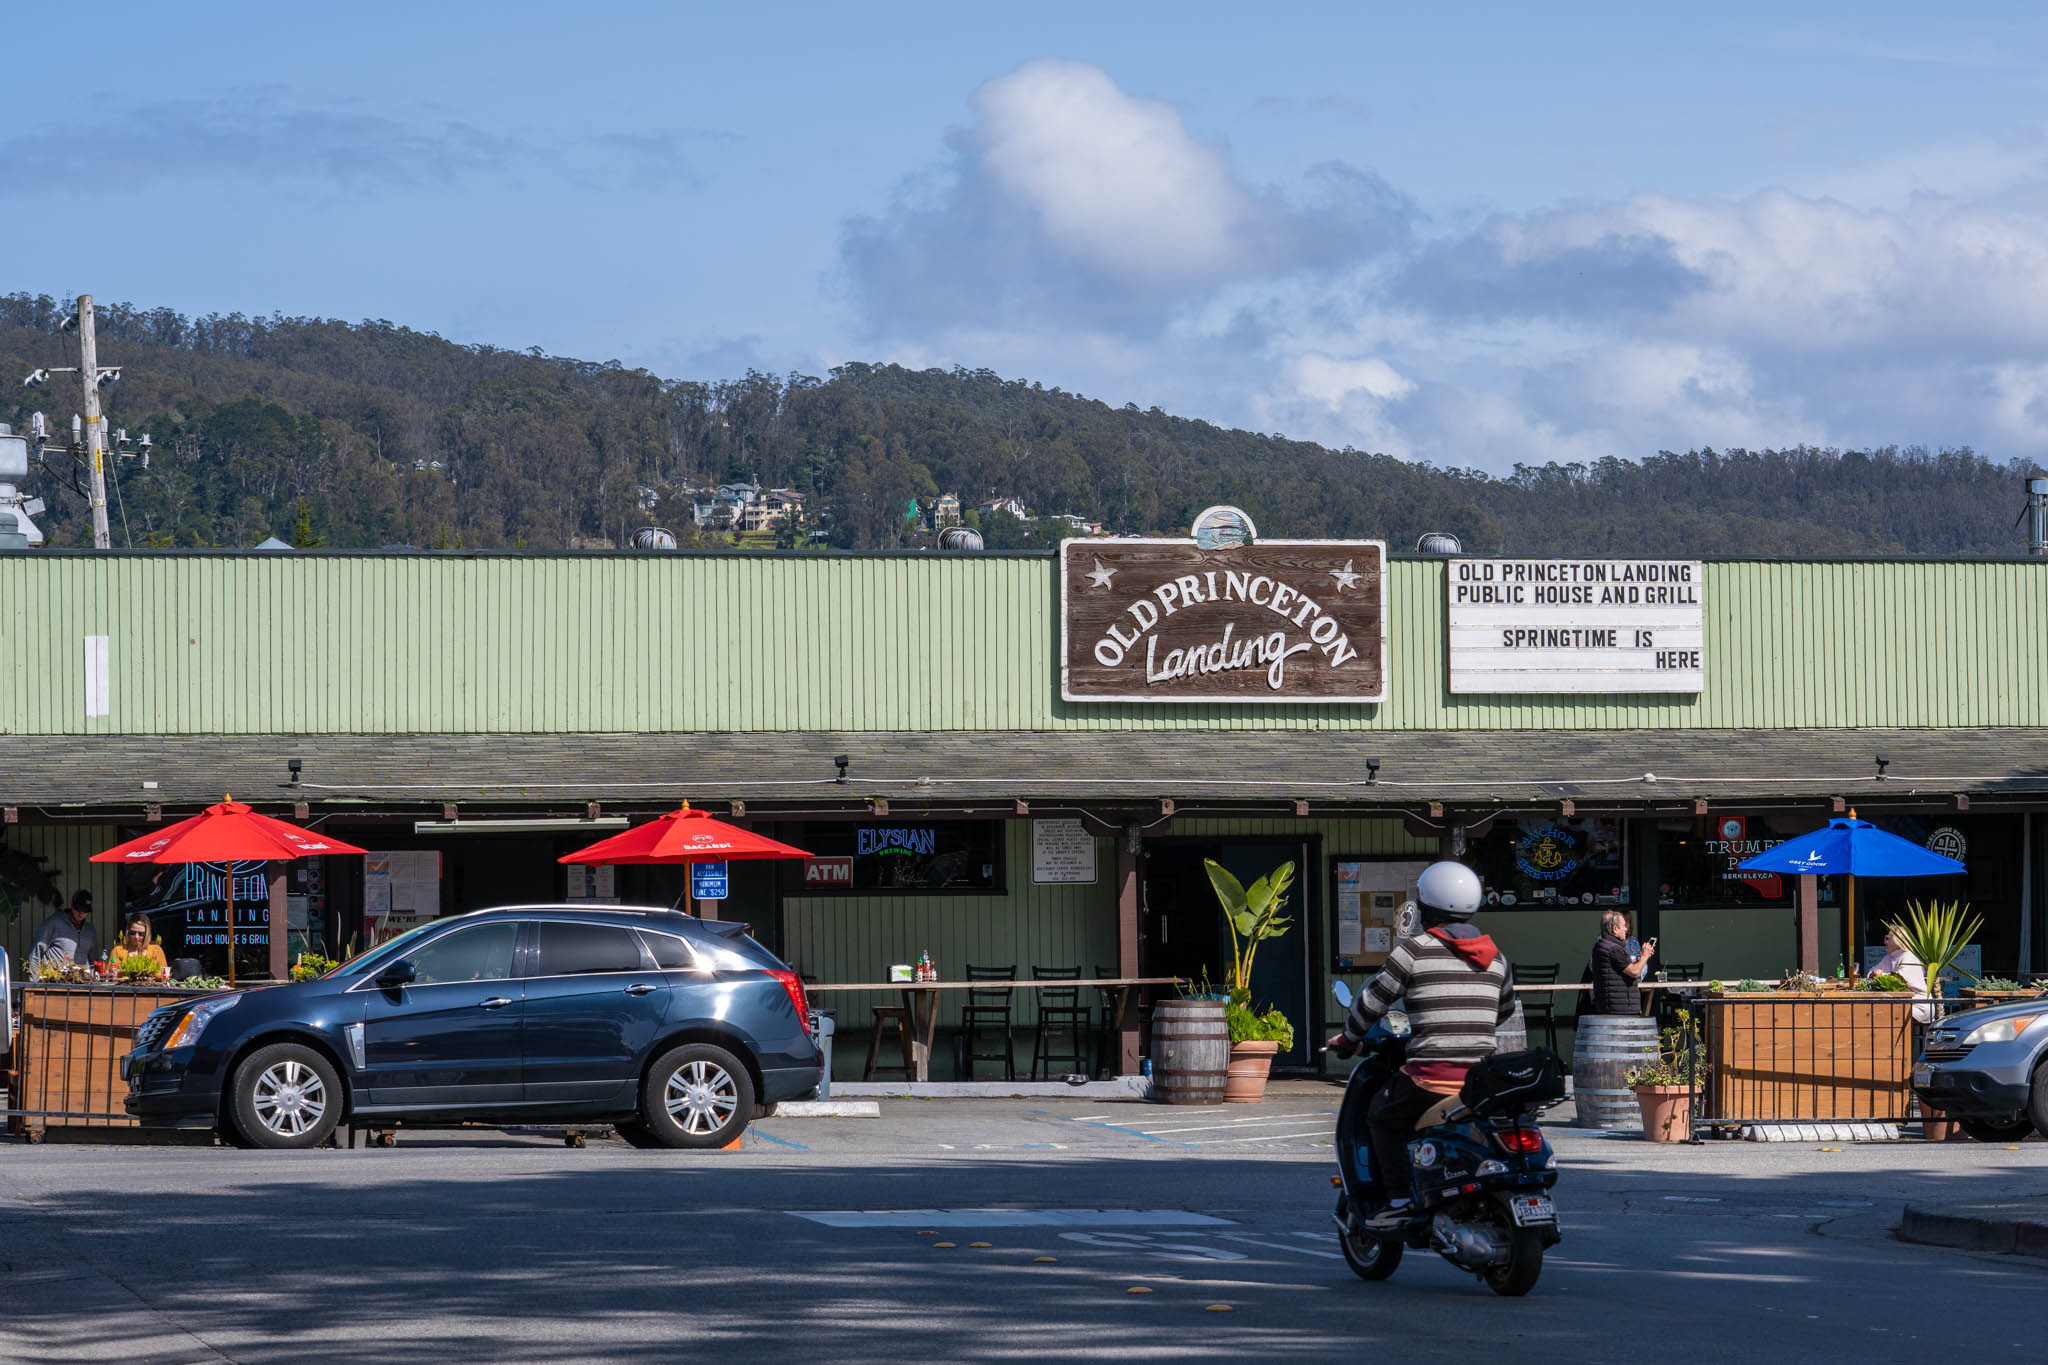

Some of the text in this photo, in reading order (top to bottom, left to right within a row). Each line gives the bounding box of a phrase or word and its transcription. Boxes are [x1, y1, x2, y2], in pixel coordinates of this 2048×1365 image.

[1460, 564, 1691, 582] OLD PRINCETON LANDING
[1457, 585, 1698, 604] PUBLIC HOUSE AND GRILL
[1094, 570, 1357, 667] OLD PRINCETON
[1503, 629, 1653, 648] SPRINGTIME IS
[1146, 623, 1312, 690] Landing
[1656, 651, 1699, 669] HERE
[857, 828, 935, 855] ELYSIAN
[1705, 839, 1785, 854] TRUME
[879, 847, 913, 857] BREWING
[806, 864, 849, 881] ATM
[1517, 857, 1577, 881] BREWING
[696, 888, 707, 896] FINE
[699, 880, 721, 888] MINIMUM
[185, 934, 269, 945] PUBLIC HOUE & GRILL
